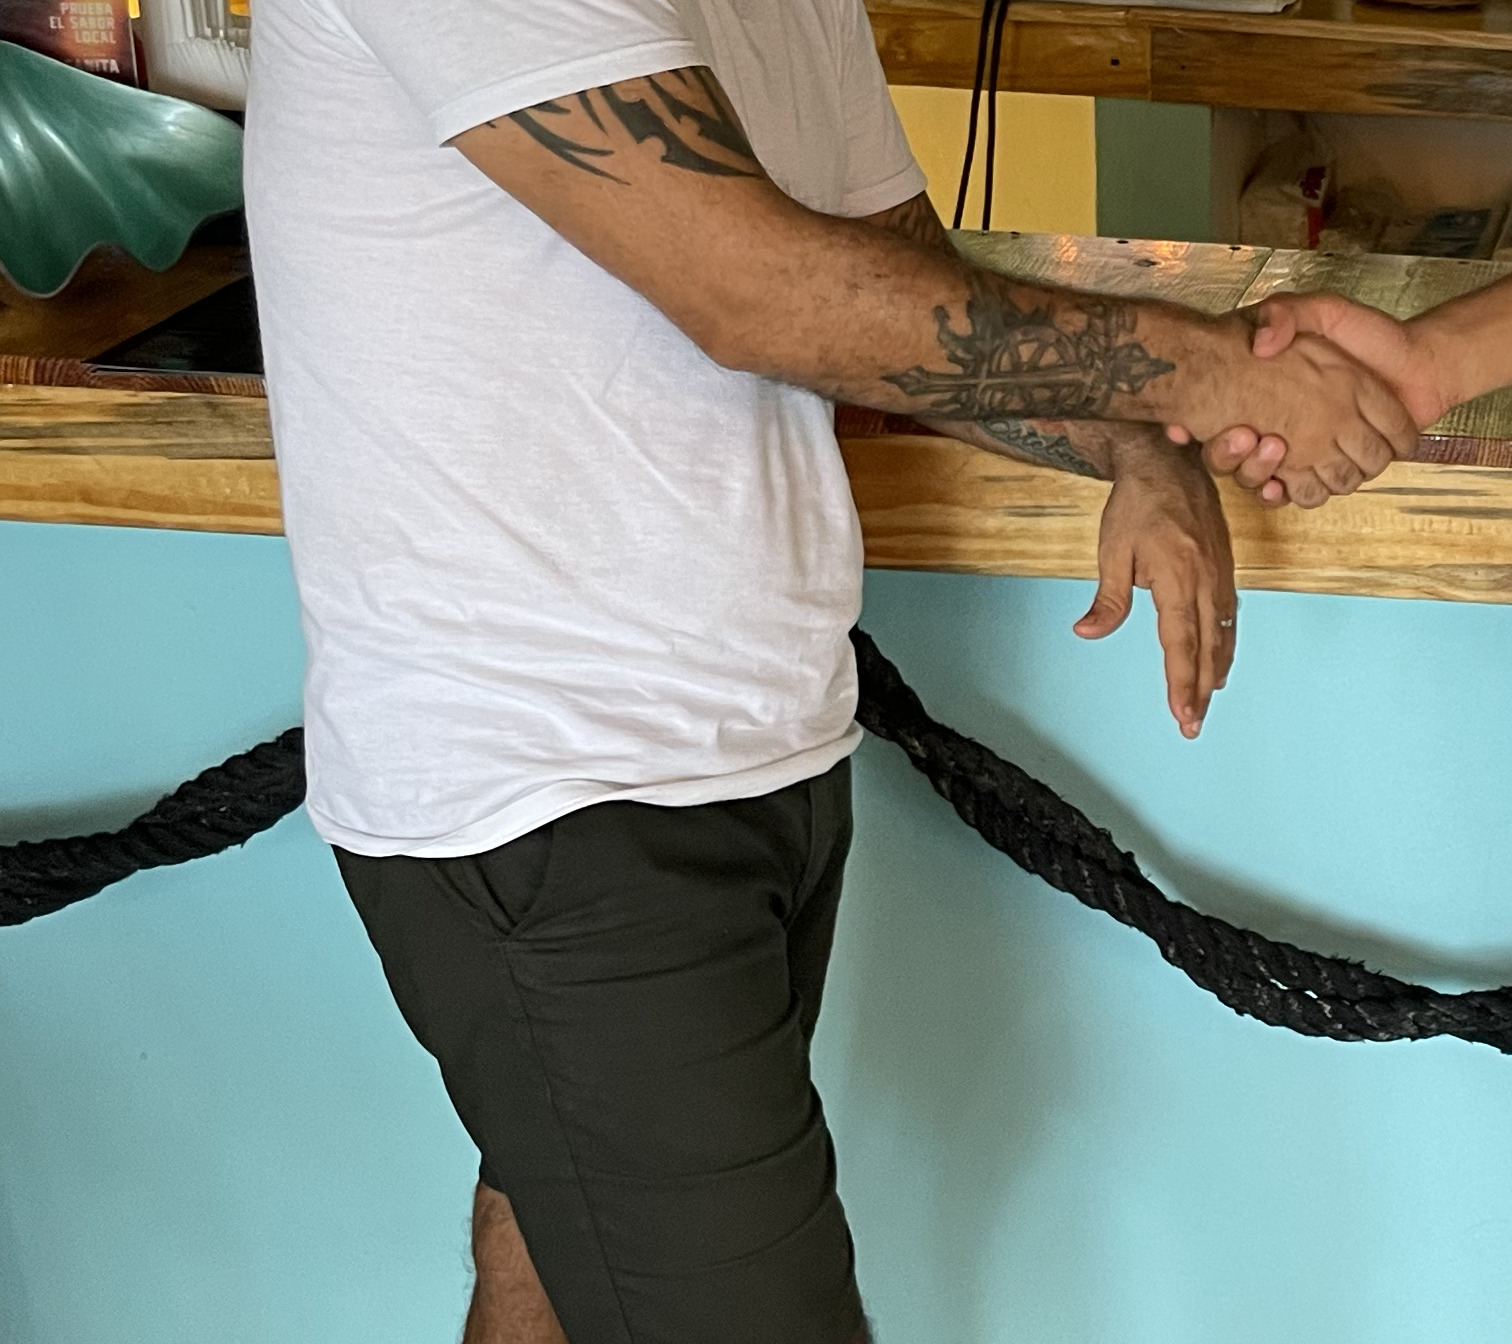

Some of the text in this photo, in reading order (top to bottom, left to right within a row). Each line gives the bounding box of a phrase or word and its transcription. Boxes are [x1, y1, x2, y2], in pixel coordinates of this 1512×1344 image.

[60, 2, 114, 16] PRUEBA
[49, 16, 115, 30] EL SABOR
[75, 30, 117, 44] LOCAL
